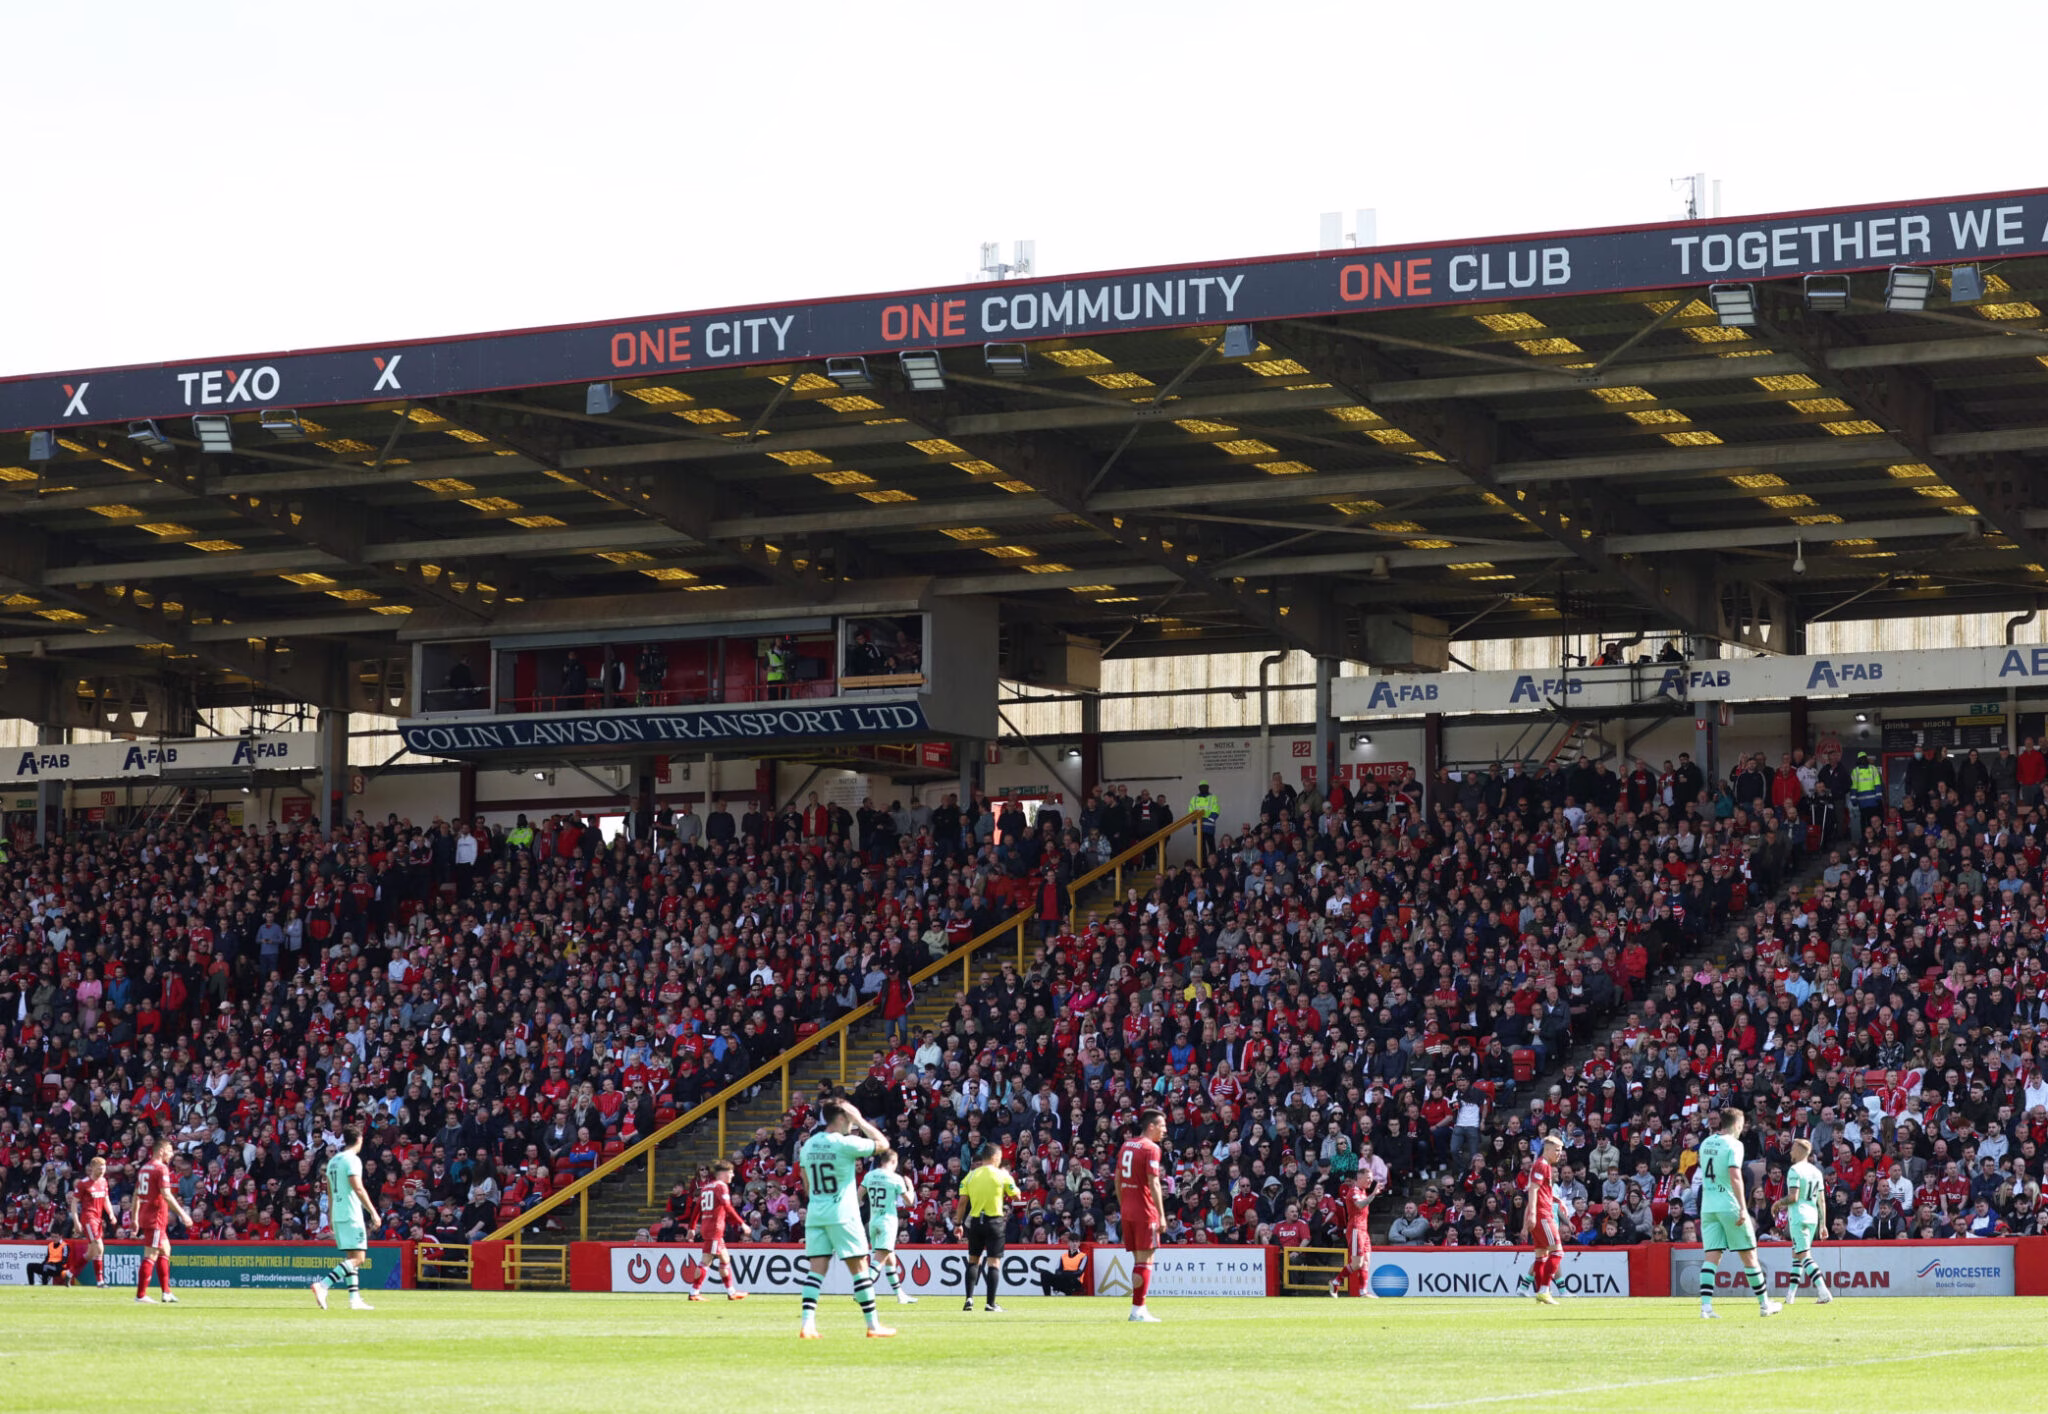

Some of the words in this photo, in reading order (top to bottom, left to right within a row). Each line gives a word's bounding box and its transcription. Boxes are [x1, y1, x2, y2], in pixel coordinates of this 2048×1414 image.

[1671, 215, 1931, 275] TOGETHER
[1949, 206, 2024, 250] WE
[1340, 258, 1432, 301] ONE
[1449, 247, 1571, 292] CLUB
[881, 299, 966, 341] ONE
[982, 274, 1244, 333] COMMUNITY
[611, 326, 691, 367] ONE
[705, 315, 795, 358] CITY
[177, 365, 280, 406] TEXO
[408, 726, 503, 750] COLIN
[506, 718, 644, 745] LAWSON
[647, 709, 846, 739] TRANSPORT
[850, 706, 918, 729] LTD
[1294, 743, 1310, 756] 22
[1360, 765, 1404, 777] LADIES
[1122, 1150, 1133, 1178] 9
[1705, 1157, 1716, 1182] 4
[811, 1162, 838, 1195] 16
[701, 1190, 714, 1211] 20
[869, 1187, 887, 1208] 32
[6, 1262, 20, 1270] Test
[104, 1254, 141, 1267] BAXTER
[1153, 1262, 1206, 1271] TUART
[1217, 1262, 1264, 1271] THOM
[104, 1267, 140, 1284] STOREY
[178, 1279, 200, 1287] 01224
[1418, 1273, 1509, 1293] KONICA
[1935, 1267, 2000, 1278] WORCESTER
